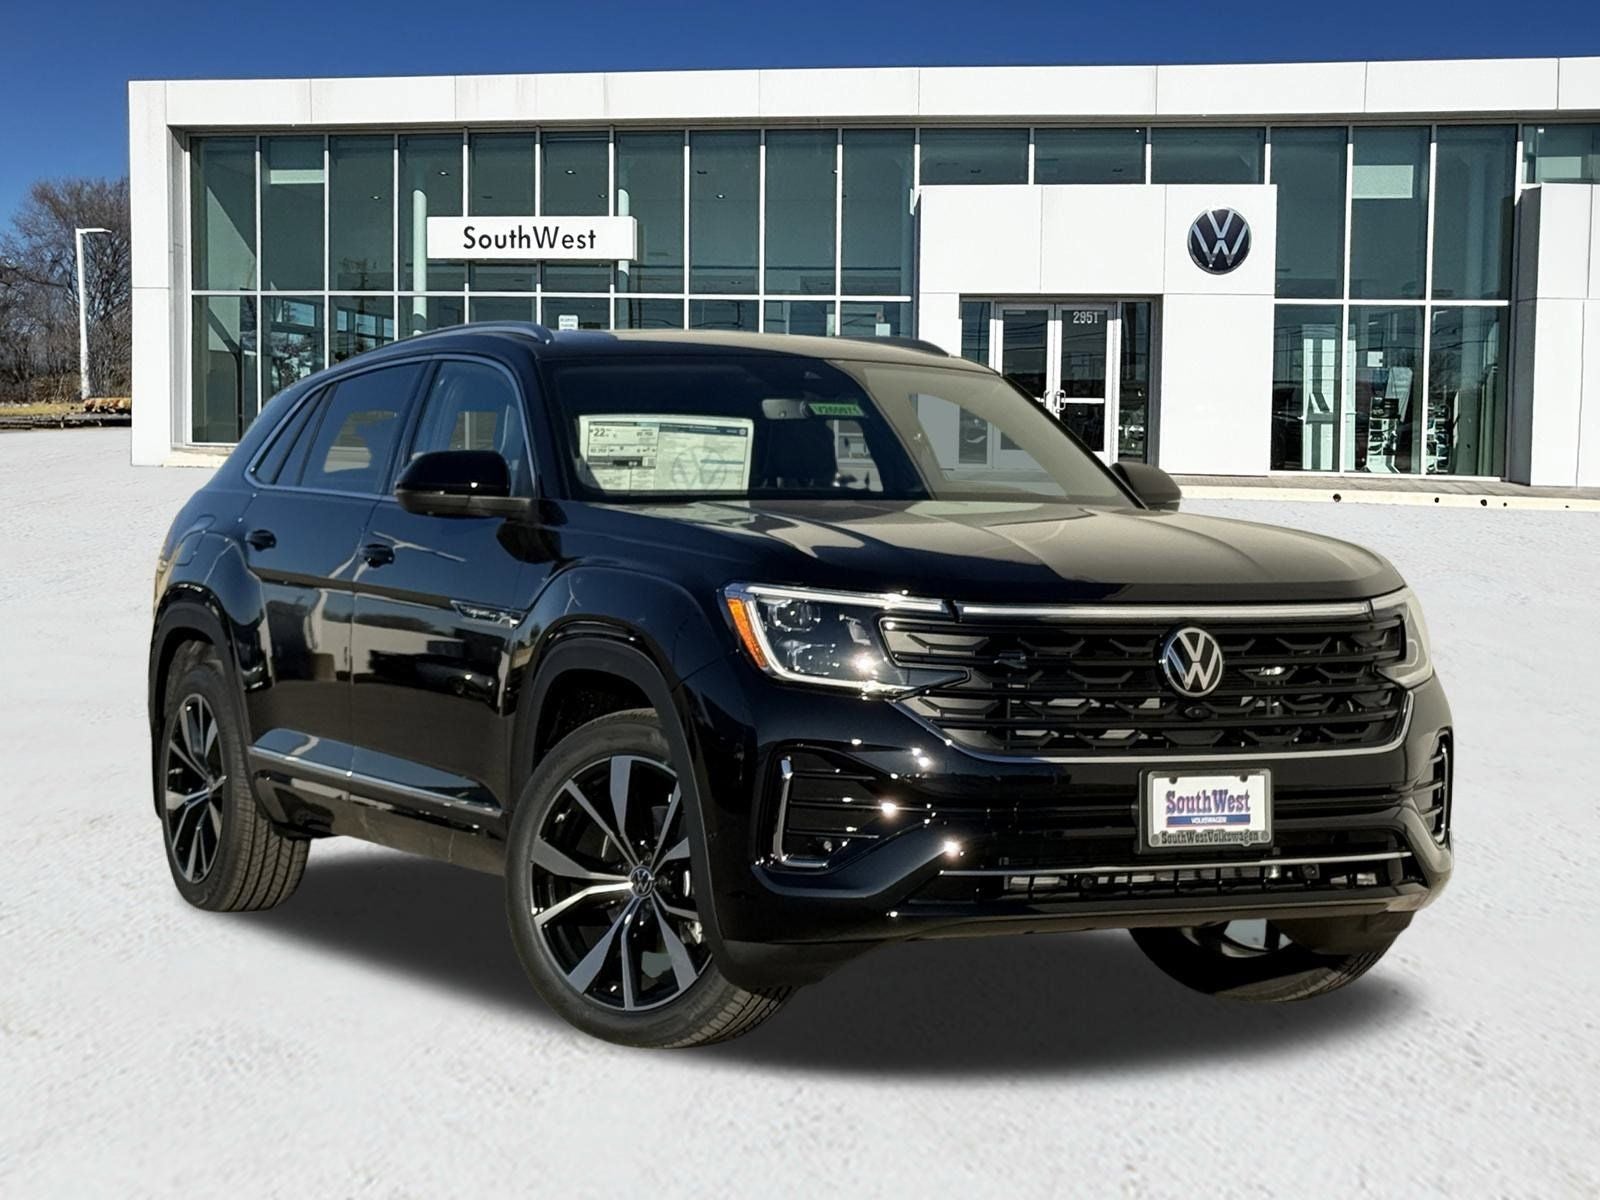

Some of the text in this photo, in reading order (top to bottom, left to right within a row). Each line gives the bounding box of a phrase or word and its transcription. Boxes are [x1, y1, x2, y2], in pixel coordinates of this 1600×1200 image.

[463, 225, 596, 249] SouthWest
[1190, 208, 1250, 267] VW
[1072, 311, 1098, 324] 2951
[1164, 628, 1222, 693] VW
[1166, 789, 1250, 814] SouthWest
